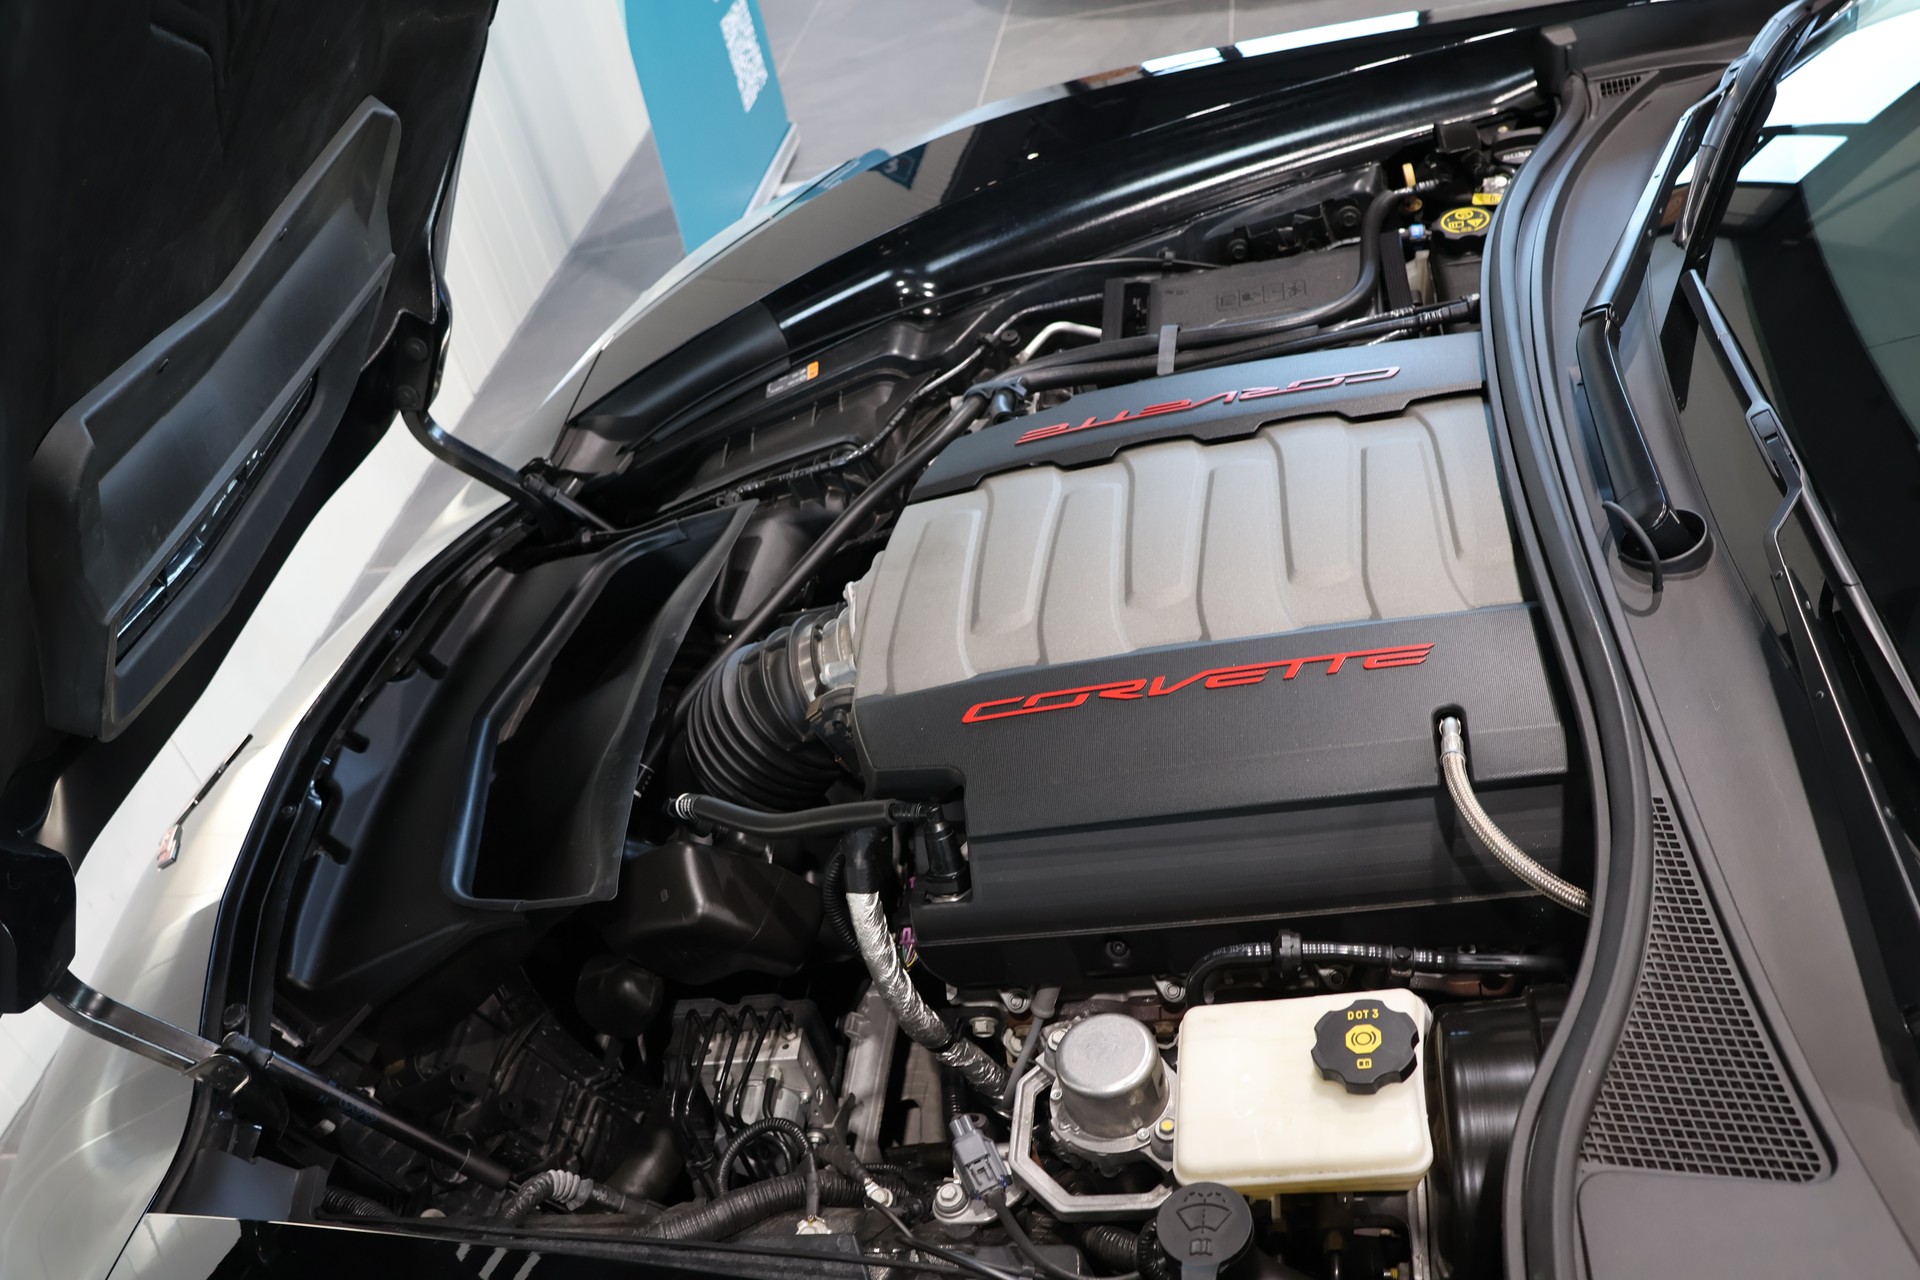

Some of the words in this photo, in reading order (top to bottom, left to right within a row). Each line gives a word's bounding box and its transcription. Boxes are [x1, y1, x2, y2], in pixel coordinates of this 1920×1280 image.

[1014, 366, 1402, 446] CORVETTE
[961, 643, 1436, 724] CORVETTE
[1347, 1009, 1369, 1020] DOT
[1372, 1008, 1379, 1019] 3
